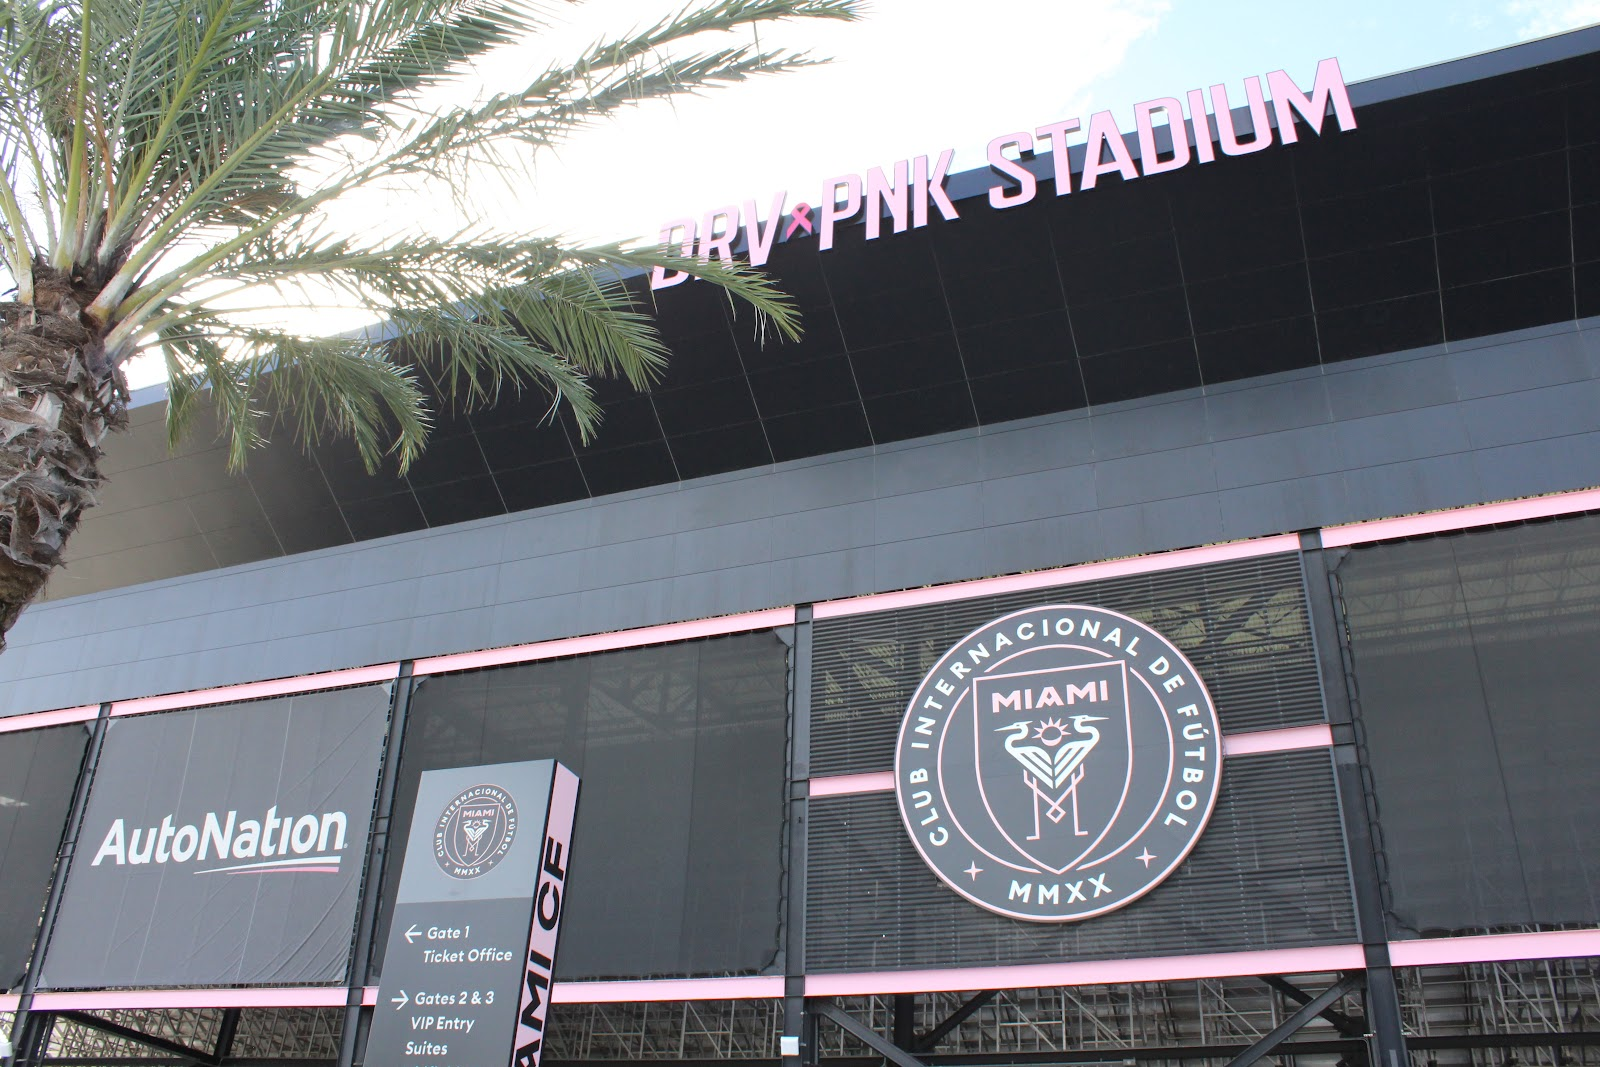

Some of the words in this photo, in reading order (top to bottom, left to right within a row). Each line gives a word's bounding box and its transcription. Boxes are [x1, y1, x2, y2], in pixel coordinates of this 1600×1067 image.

[650, 190, 788, 291] DRV
[819, 148, 961, 251] PNK
[986, 57, 1357, 210] STADIUM
[911, 618, 1140, 749] INTERNACIONAL
[1148, 655, 1185, 694] DE
[991, 680, 1109, 713] MIAMI
[1163, 704, 1210, 828] FÚTBOL
[439, 788, 507, 828] INTERNACIONAL
[462, 809, 495, 818] MIAMI
[505, 803, 514, 815] DE
[910, 767, 949, 847] CLUB
[91, 805, 347, 866] AutoNation
[436, 832, 444, 857] CLUB
[454, 866, 481, 875] MMXX
[537, 836, 564, 931] CF
[1008, 872, 1112, 905] MMXX
[427, 926, 461, 940] Gate
[464, 925, 470, 939] 1
[423, 949, 465, 963] Ticket
[467, 947, 513, 962] Office
[415, 991, 456, 1005] Gates
[458, 991, 468, 1005] 2
[470, 990, 482, 1005] &
[485, 990, 495, 1005] 3
[411, 1016, 435, 1030] VIP
[436, 1016, 475, 1034] Entry
[405, 1041, 448, 1055] Suites
